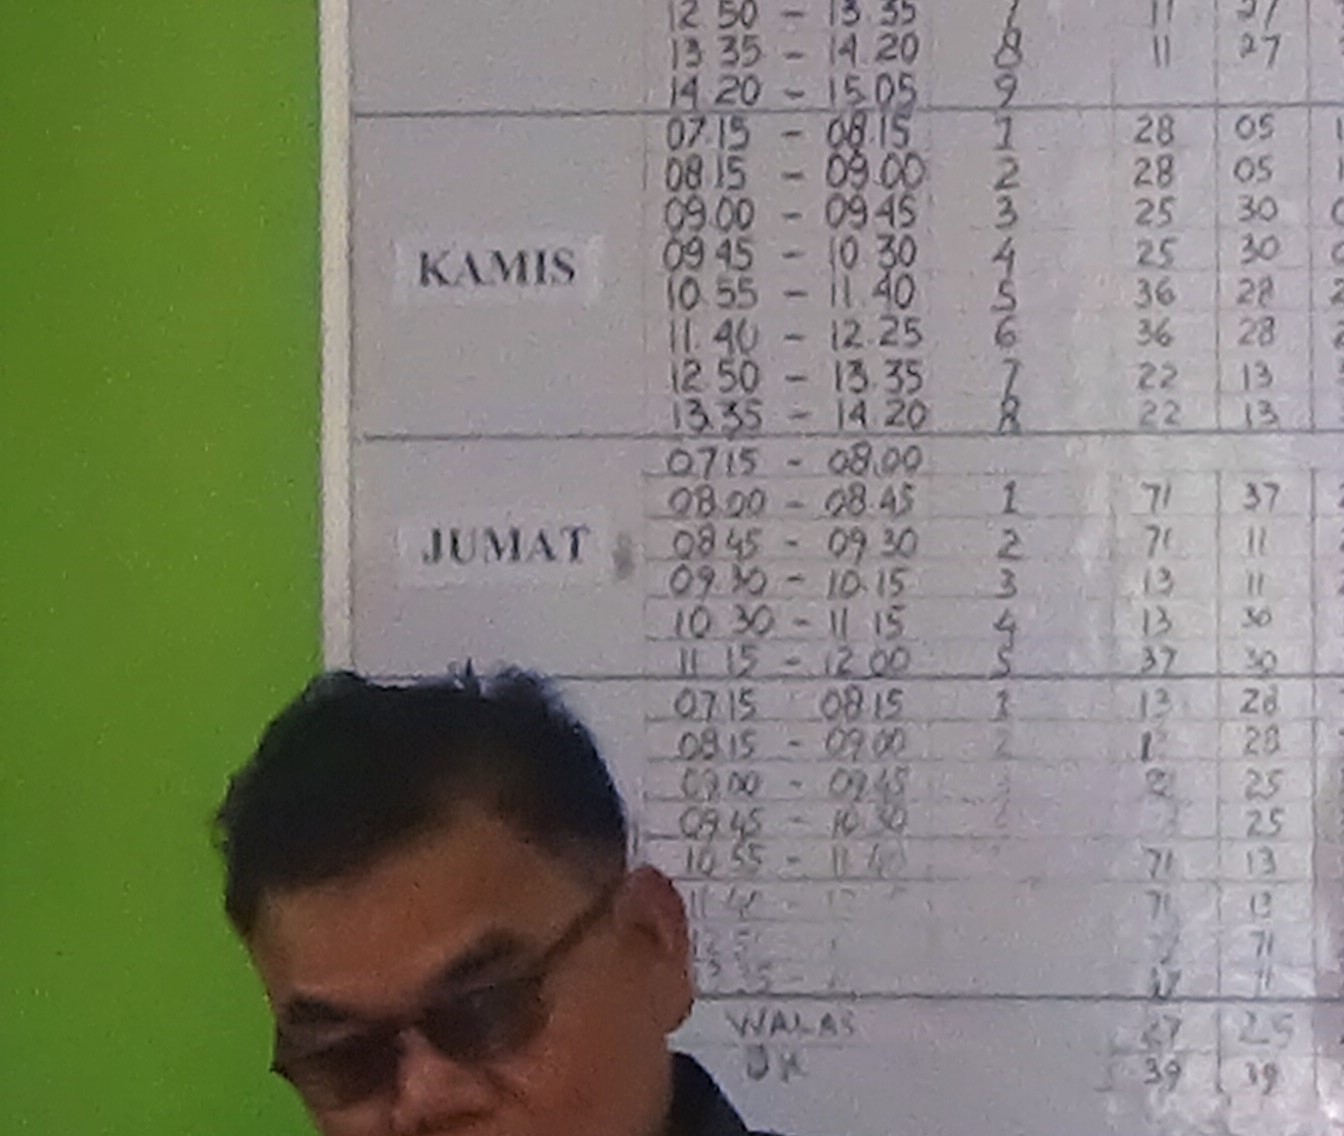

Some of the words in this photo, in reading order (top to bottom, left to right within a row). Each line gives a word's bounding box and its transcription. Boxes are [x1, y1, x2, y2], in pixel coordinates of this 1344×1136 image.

[1152, 35, 1172, 67] 11
[995, 77, 1017, 107] 9
[994, 159, 1019, 189] 2
[1134, 156, 1174, 186] 28
[1234, 156, 1272, 183] 05
[996, 198, 1017, 227] 3
[993, 238, 1014, 277] 4
[1137, 237, 1178, 266] 25
[1241, 235, 1279, 260] 30
[419, 250, 575, 288] KAMIS
[992, 281, 1017, 312] 5
[996, 318, 1015, 346] 6
[1003, 360, 1021, 394] 7
[1003, 482, 1016, 513] 1
[1141, 483, 1172, 509] 71
[1244, 482, 1279, 509] 37
[422, 528, 590, 565] JUMAT
[998, 529, 1022, 559] 2
[998, 569, 1017, 597] 3
[1145, 567, 1173, 593] 13
[1248, 569, 1264, 592] 11
[994, 611, 1016, 646] 4
[991, 649, 1010, 677] 5
[1246, 770, 1282, 797] 25
